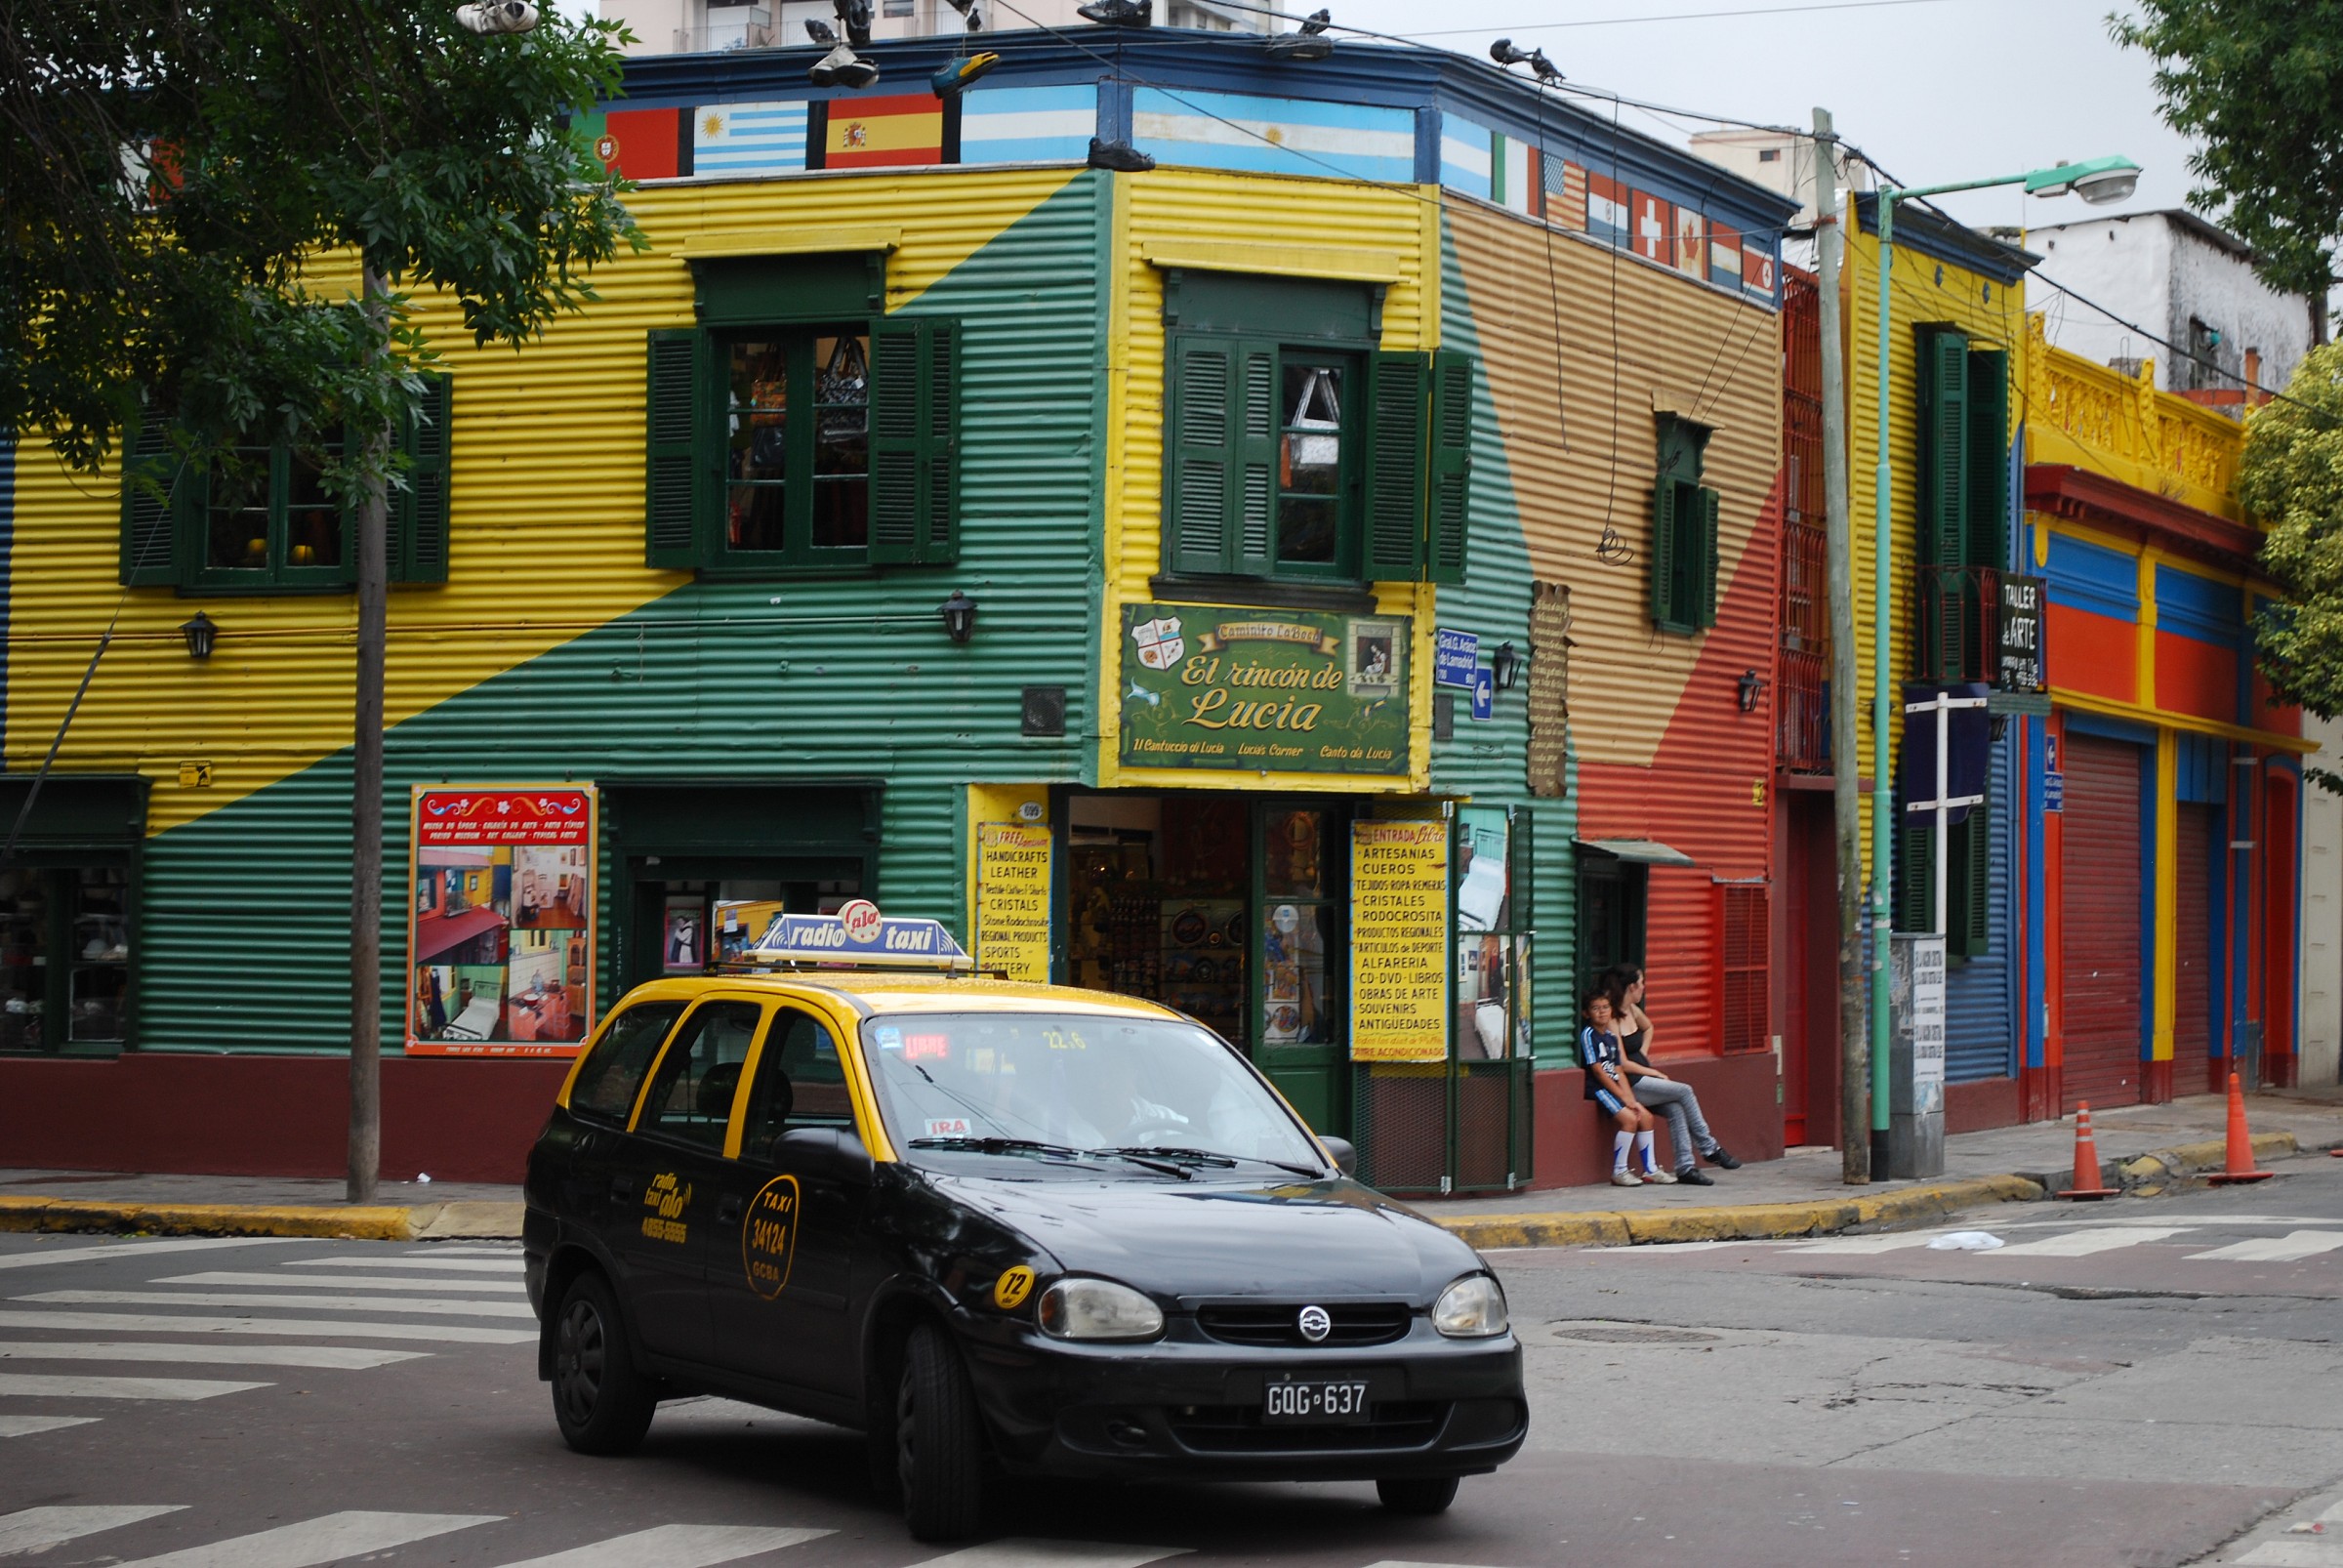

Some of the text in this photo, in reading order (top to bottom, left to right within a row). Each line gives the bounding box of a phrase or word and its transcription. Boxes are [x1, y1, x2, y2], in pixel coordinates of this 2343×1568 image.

[2005, 584, 2035, 610] TALLER
[1218, 624, 1273, 640] Caminito
[2010, 616, 2035, 650] ARTE
[1181, 655, 1344, 689] El rincón de
[1143, 739, 1188, 753] Cantuccio
[1189, 741, 1199, 753] di
[1269, 743, 1303, 757] Corner
[1320, 745, 1347, 758] Canto
[1350, 746, 1364, 759] da
[1374, 825, 1445, 846] ENTRADA Libre
[986, 851, 1048, 862] HANDICRAFTS
[1363, 847, 1435, 859] ARTESANIAS
[991, 867, 1038, 878] LEATHER
[1362, 863, 1416, 875] CUEROS
[1356, 880, 1387, 890] TEJIDOS
[1413, 880, 1446, 890] REMERAS
[990, 899, 1038, 911] CRISTALS
[1362, 894, 1425, 906] CRISTALES
[1362, 910, 1442, 921] RODOCROSITA
[791, 924, 933, 950] radio taxi
[981, 930, 1048, 942] REGIONAL PRODUCTS
[1357, 927, 1444, 937] PRODUCTOS REGIONALES
[985, 946, 1020, 958] SPORTS
[1359, 942, 1444, 953] ARTICULOS de DEPORTE
[985, 963, 1030, 974] POTTERY
[1362, 957, 1428, 969] ALFARERIA
[1359, 988, 1438, 999] OBRAS DE ARTE
[1359, 1004, 1417, 1013] SOUVENIRS
[1359, 1016, 1440, 1029] ANTIGÜEDADES
[906, 1035, 947, 1059] LIBRE
[931, 1120, 966, 1134] IRA
[652, 1173, 677, 1190] radio
[644, 1187, 683, 1219] taxi alo
[763, 1191, 794, 1213] TAXI
[752, 1218, 786, 1256] 34124
[753, 1260, 779, 1281] GCBA
[1268, 1385, 1366, 1415] GQG 637
